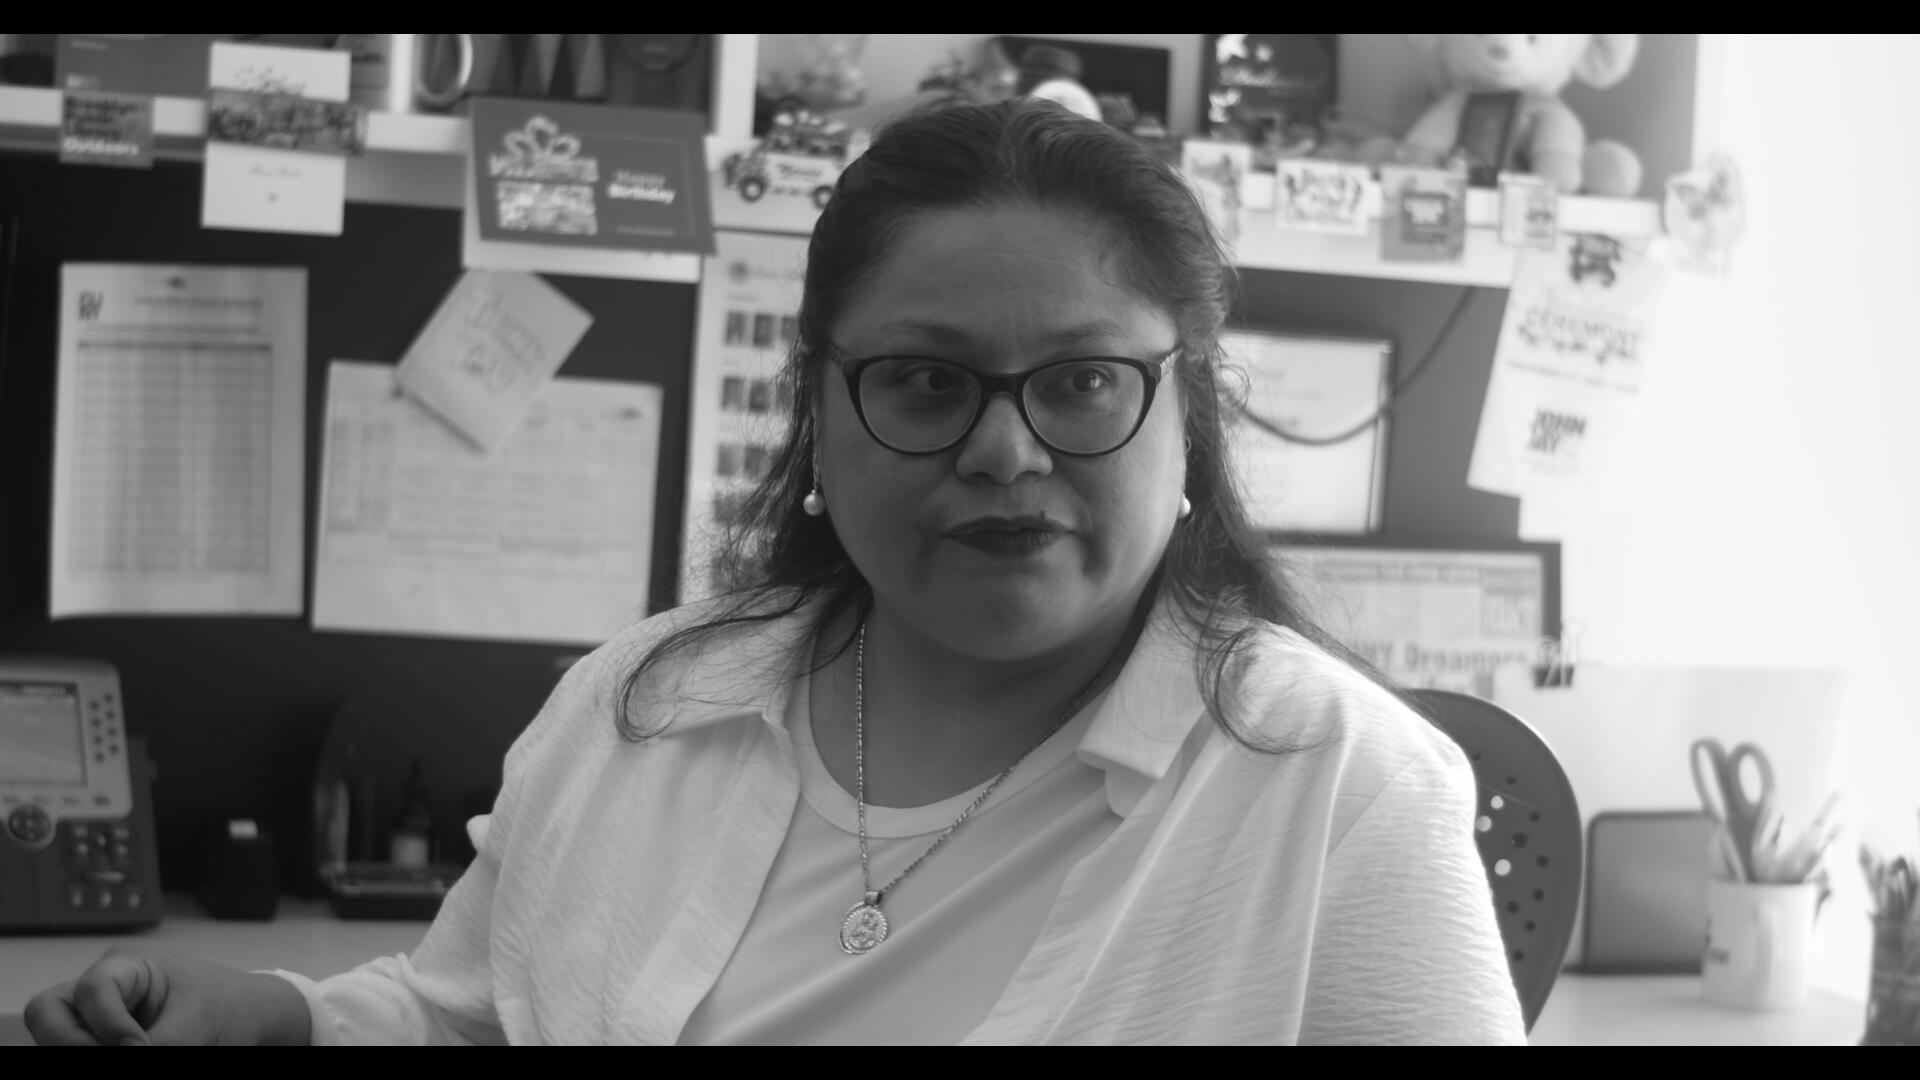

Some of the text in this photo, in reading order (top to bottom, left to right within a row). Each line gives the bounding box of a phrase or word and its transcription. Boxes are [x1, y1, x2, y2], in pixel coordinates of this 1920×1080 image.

[63, 137, 139, 155] Outdoors
[616, 170, 666, 187] Happy
[607, 184, 676, 205] Birthday
[1532, 409, 1587, 437] JOHN
[1405, 642, 1528, 671] Dreamers
